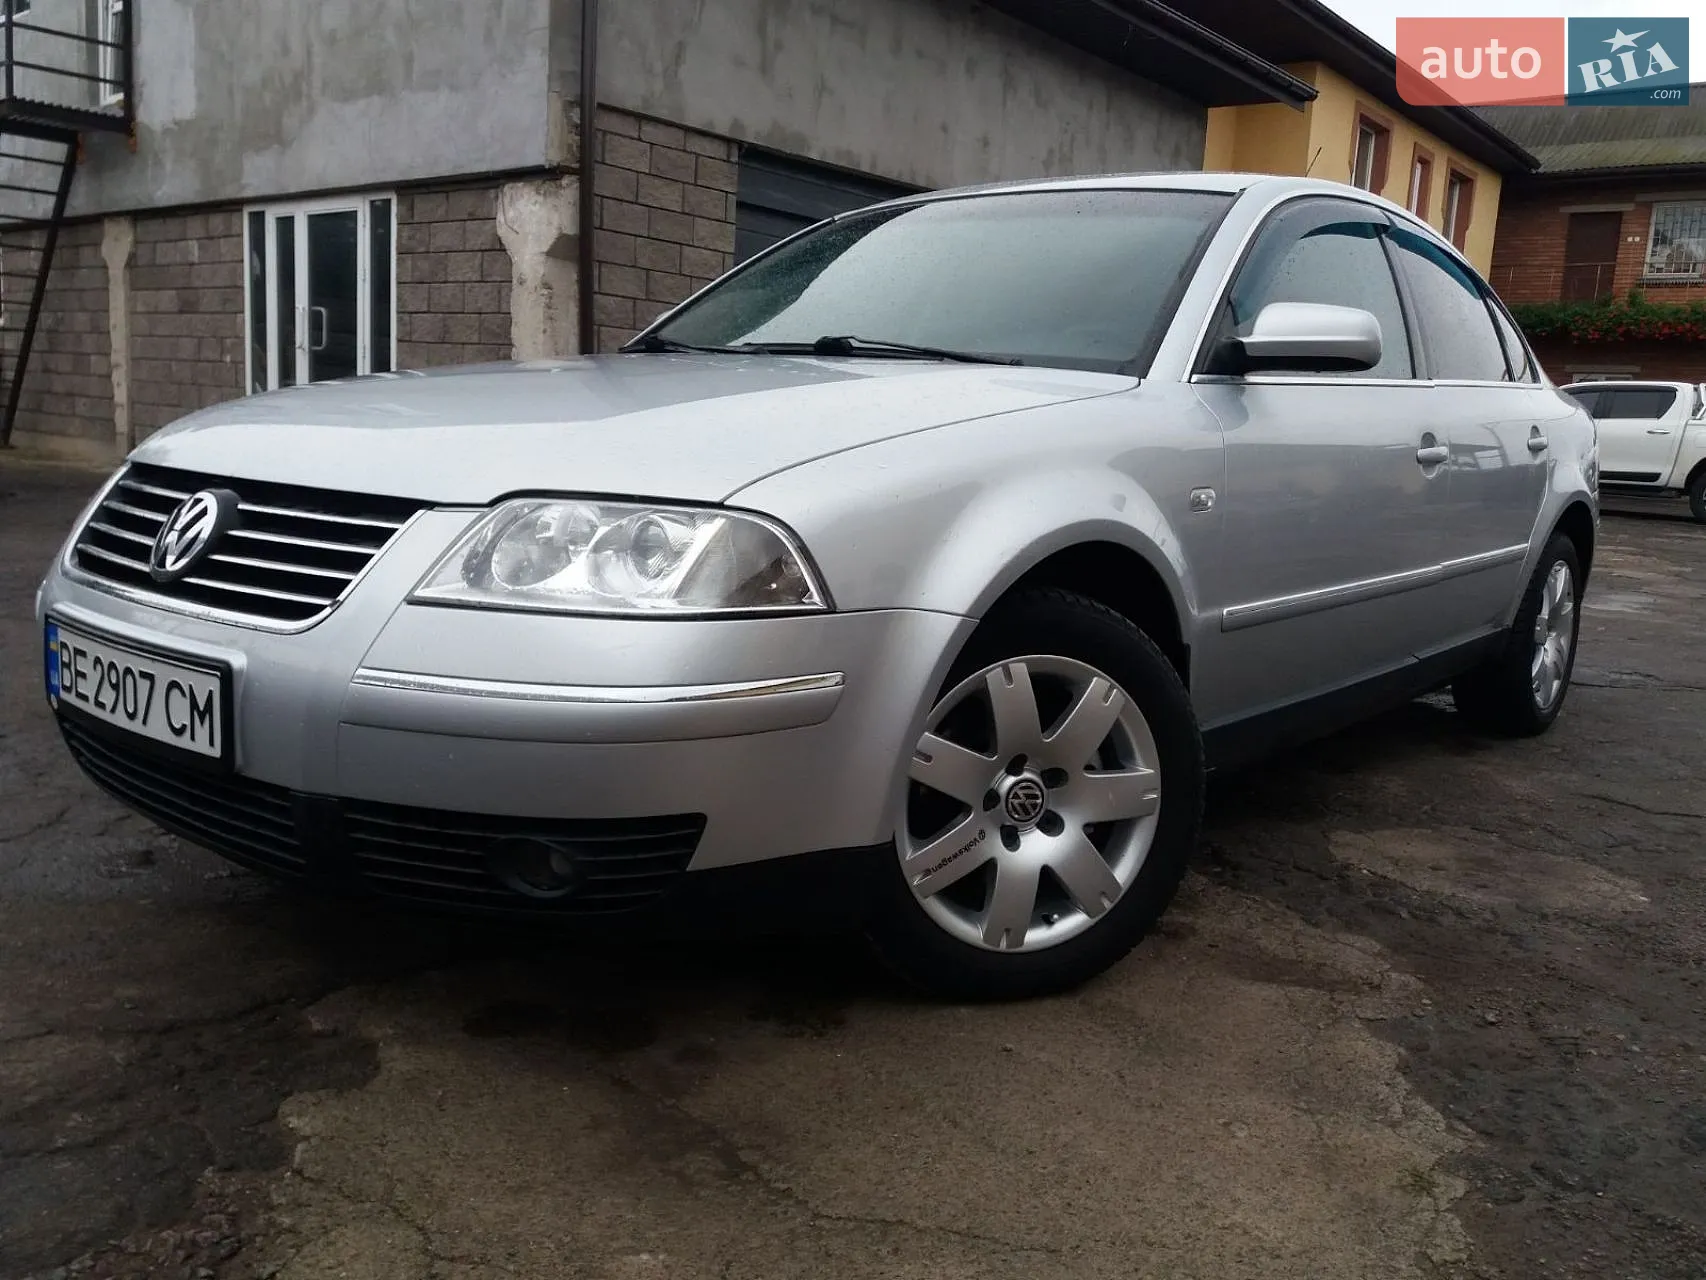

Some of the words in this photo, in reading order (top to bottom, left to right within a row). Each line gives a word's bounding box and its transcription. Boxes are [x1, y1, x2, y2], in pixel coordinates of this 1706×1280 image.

[59, 640, 90, 704] BE
[92, 655, 156, 727] 2907
[164, 679, 215, 748] CM
